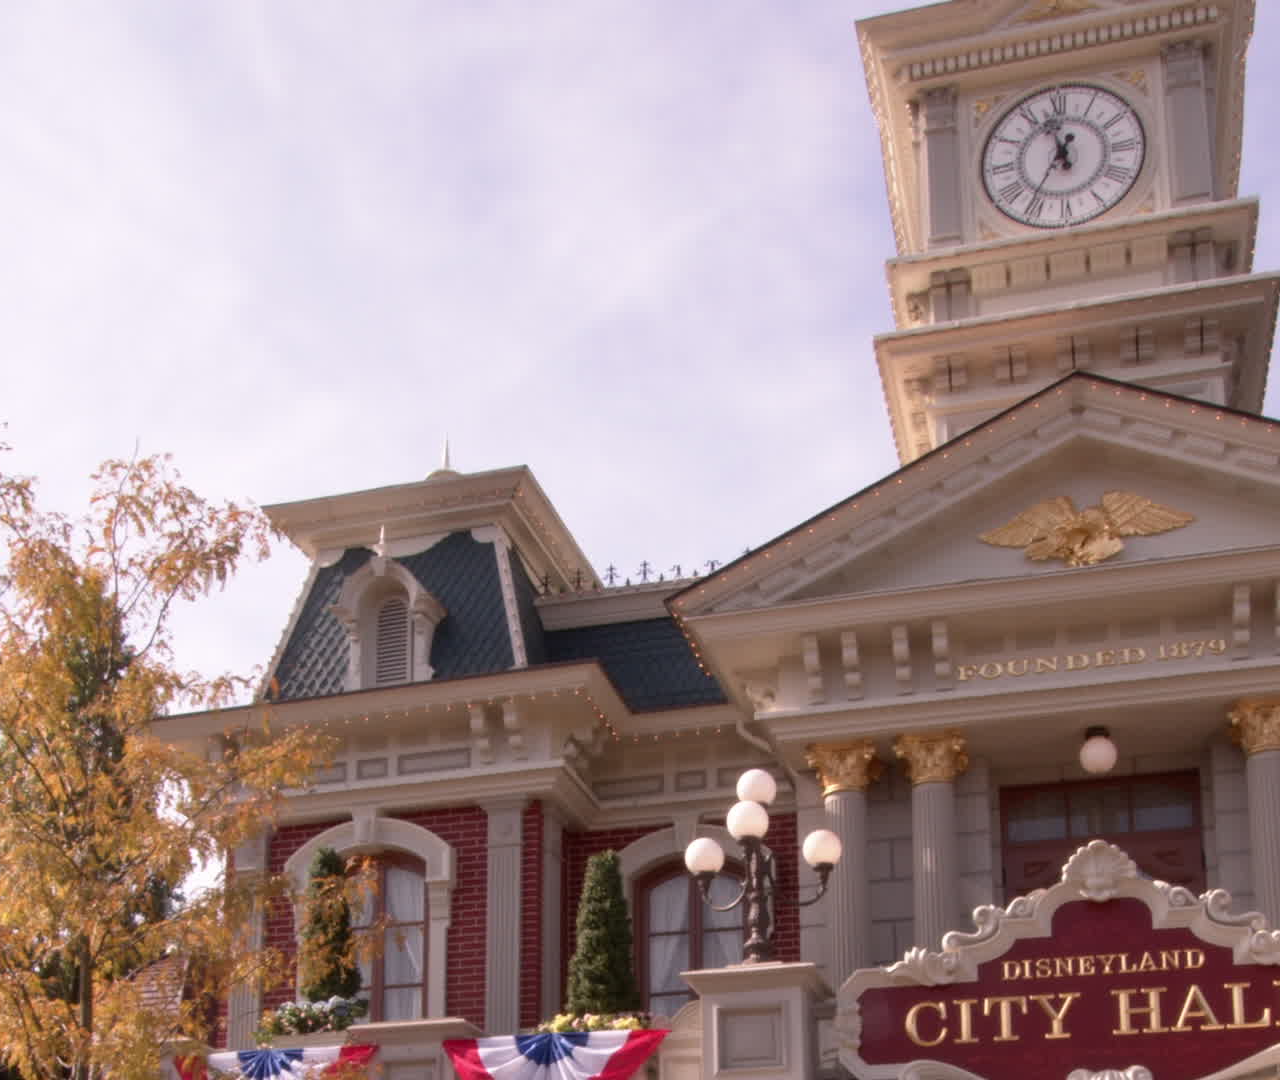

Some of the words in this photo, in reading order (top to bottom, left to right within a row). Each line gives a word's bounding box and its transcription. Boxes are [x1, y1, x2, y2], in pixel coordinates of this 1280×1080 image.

[957, 648, 1146, 681] FOUNDED
[1158, 639, 1227, 660] 1879
[1001, 948, 1205, 980] DISNEYLAND
[904, 992, 1081, 1046] CITY
